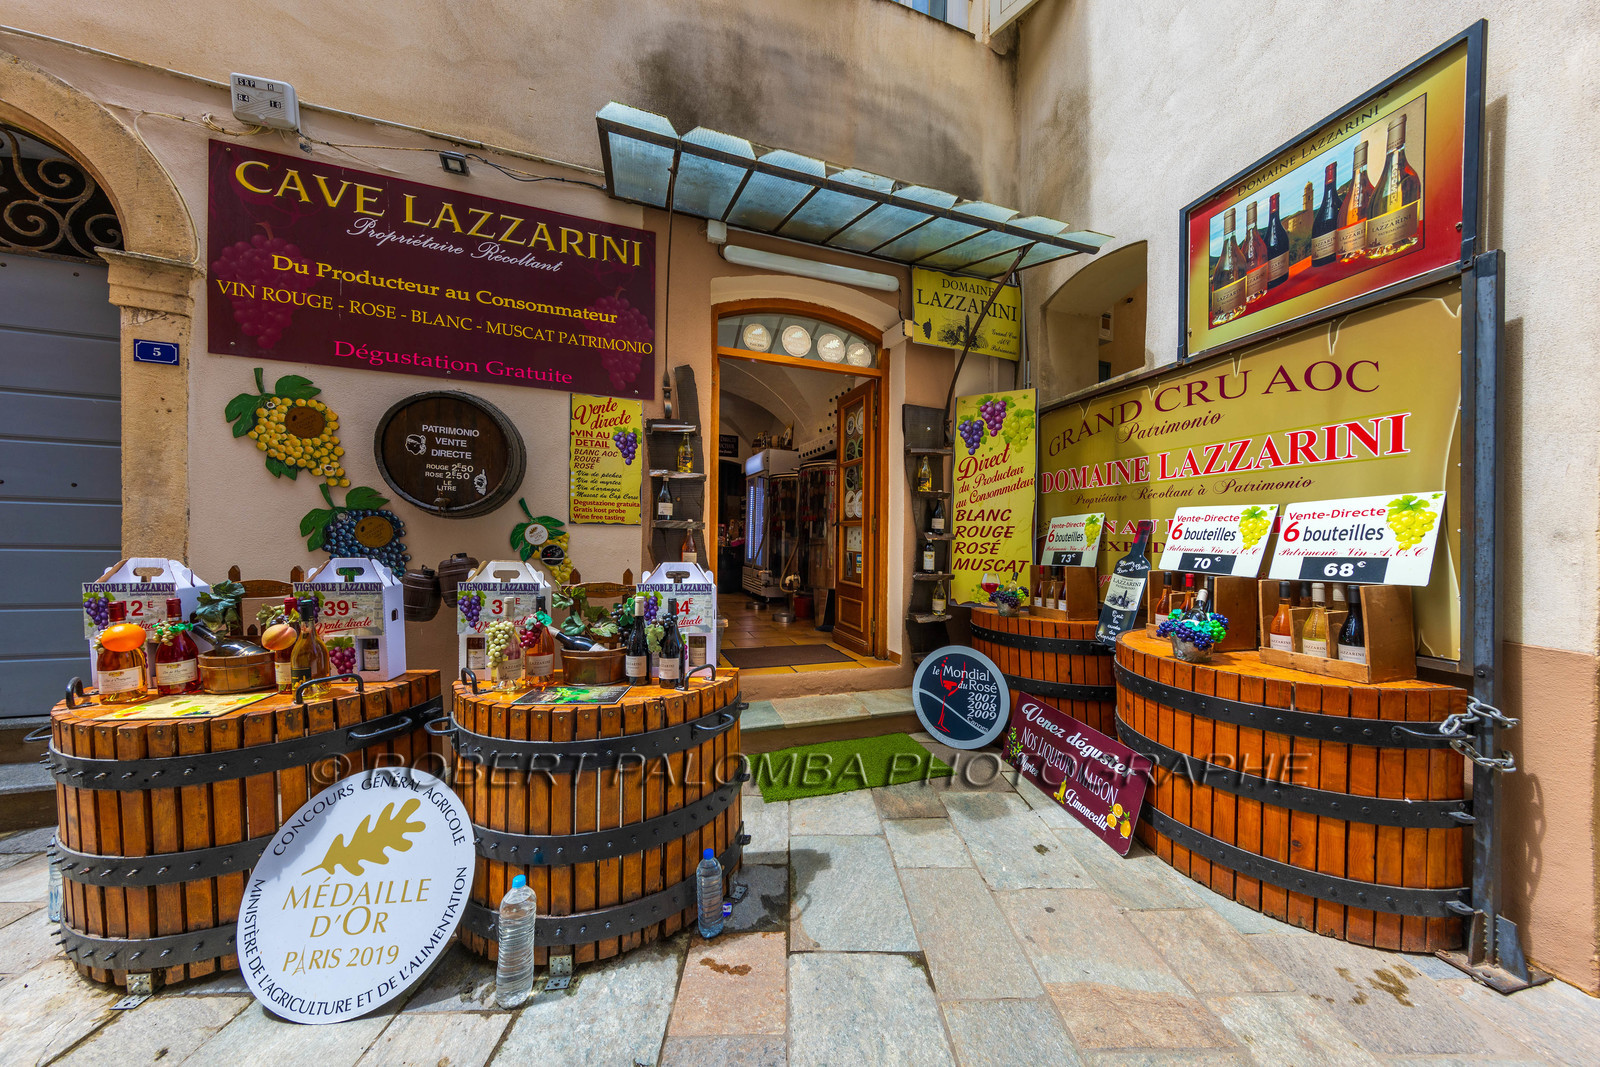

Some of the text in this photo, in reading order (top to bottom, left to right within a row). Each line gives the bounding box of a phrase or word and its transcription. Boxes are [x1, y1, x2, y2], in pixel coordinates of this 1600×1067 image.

[1237, 104, 1380, 198] DOMAINE LAZZARINI
[235, 160, 643, 267] CAVE LAZZARINI
[346, 217, 563, 273] Propriétaire Récoltant
[271, 254, 618, 325] Du Producteur au Consommateur
[916, 278, 1017, 322] DOMAINE LAZZARINI
[216, 279, 653, 355] VIN ROUGE ROSE BLANC MUSCAT PATRIMONIO
[153, 347, 161, 357] 5
[334, 340, 573, 384] Dégustation Gratuite
[574, 397, 618, 425] Vente
[1048, 360, 1381, 458] GRAND CRU AOC
[590, 409, 632, 430] directe
[1114, 410, 1225, 445] Patrimonio
[422, 424, 480, 437] PATRIMONIO
[575, 430, 610, 439] VIN AU
[435, 437, 467, 448] VENTE
[575, 439, 610, 448] DETAIL
[431, 449, 472, 459] DIRECTE
[573, 455, 601, 463] ROUGE
[574, 448, 600, 456] BLANC
[1041, 411, 1412, 494] DOMAINE LAZZARINI
[426, 463, 449, 471] ROUGE
[957, 443, 1011, 482] Direct
[425, 471, 443, 479] ROSE
[959, 465, 1025, 495] du Producteur
[955, 477, 1035, 509] au Consommateur
[1072, 476, 1315, 509] Propriétaire Récoltant à Patrimonio
[955, 508, 1012, 522] BLANC
[1177, 514, 1240, 523] Vente-Directe
[1289, 507, 1386, 520] Vente-Directe
[954, 525, 1015, 539] ROUGE
[1051, 521, 1086, 529] Vente-Directe
[1171, 523, 1237, 541] 6 bouteilles
[1283, 521, 1384, 542] 6 bouteilles
[1048, 529, 1084, 543] 6 bouteilles
[954, 540, 1001, 555] ROSÉ
[953, 558, 1029, 573] MUSCAT
[84, 583, 175, 592] VIGNOBLE LAZZARINI
[294, 583, 382, 592] VIGNOBLE LAZZARINI
[459, 583, 540, 591] VIGNOBLE LAZZARINI
[637, 584, 712, 592] VIGNOBLE LAZZARINI
[1113, 578, 1142, 587] LAZZARINI
[315, 617, 372, 636] Vente directe
[678, 616, 702, 626] directe
[932, 665, 990, 682] le Mondial
[957, 680, 998, 694] du Rosé
[967, 692, 997, 702] 2007
[967, 700, 997, 712] 2008
[967, 709, 997, 720] 2009
[966, 716, 989, 732] Cannes
[1021, 702, 1137, 778] Venez déguster
[1017, 751, 1039, 777] Myrtes
[1021, 726, 1119, 806] NOS LIQUEURS MAISON
[273, 774, 466, 857] CONCOURS GÉNÉRAL AGRICOLE
[282, 876, 432, 910] MÉDAILLE
[310, 905, 389, 938] D'OR
[243, 866, 467, 1016] MINISTÈRE DE L'AGRICULTURE ET DE L'ALIMENTATION
[282, 945, 400, 976] PARIS 2019
